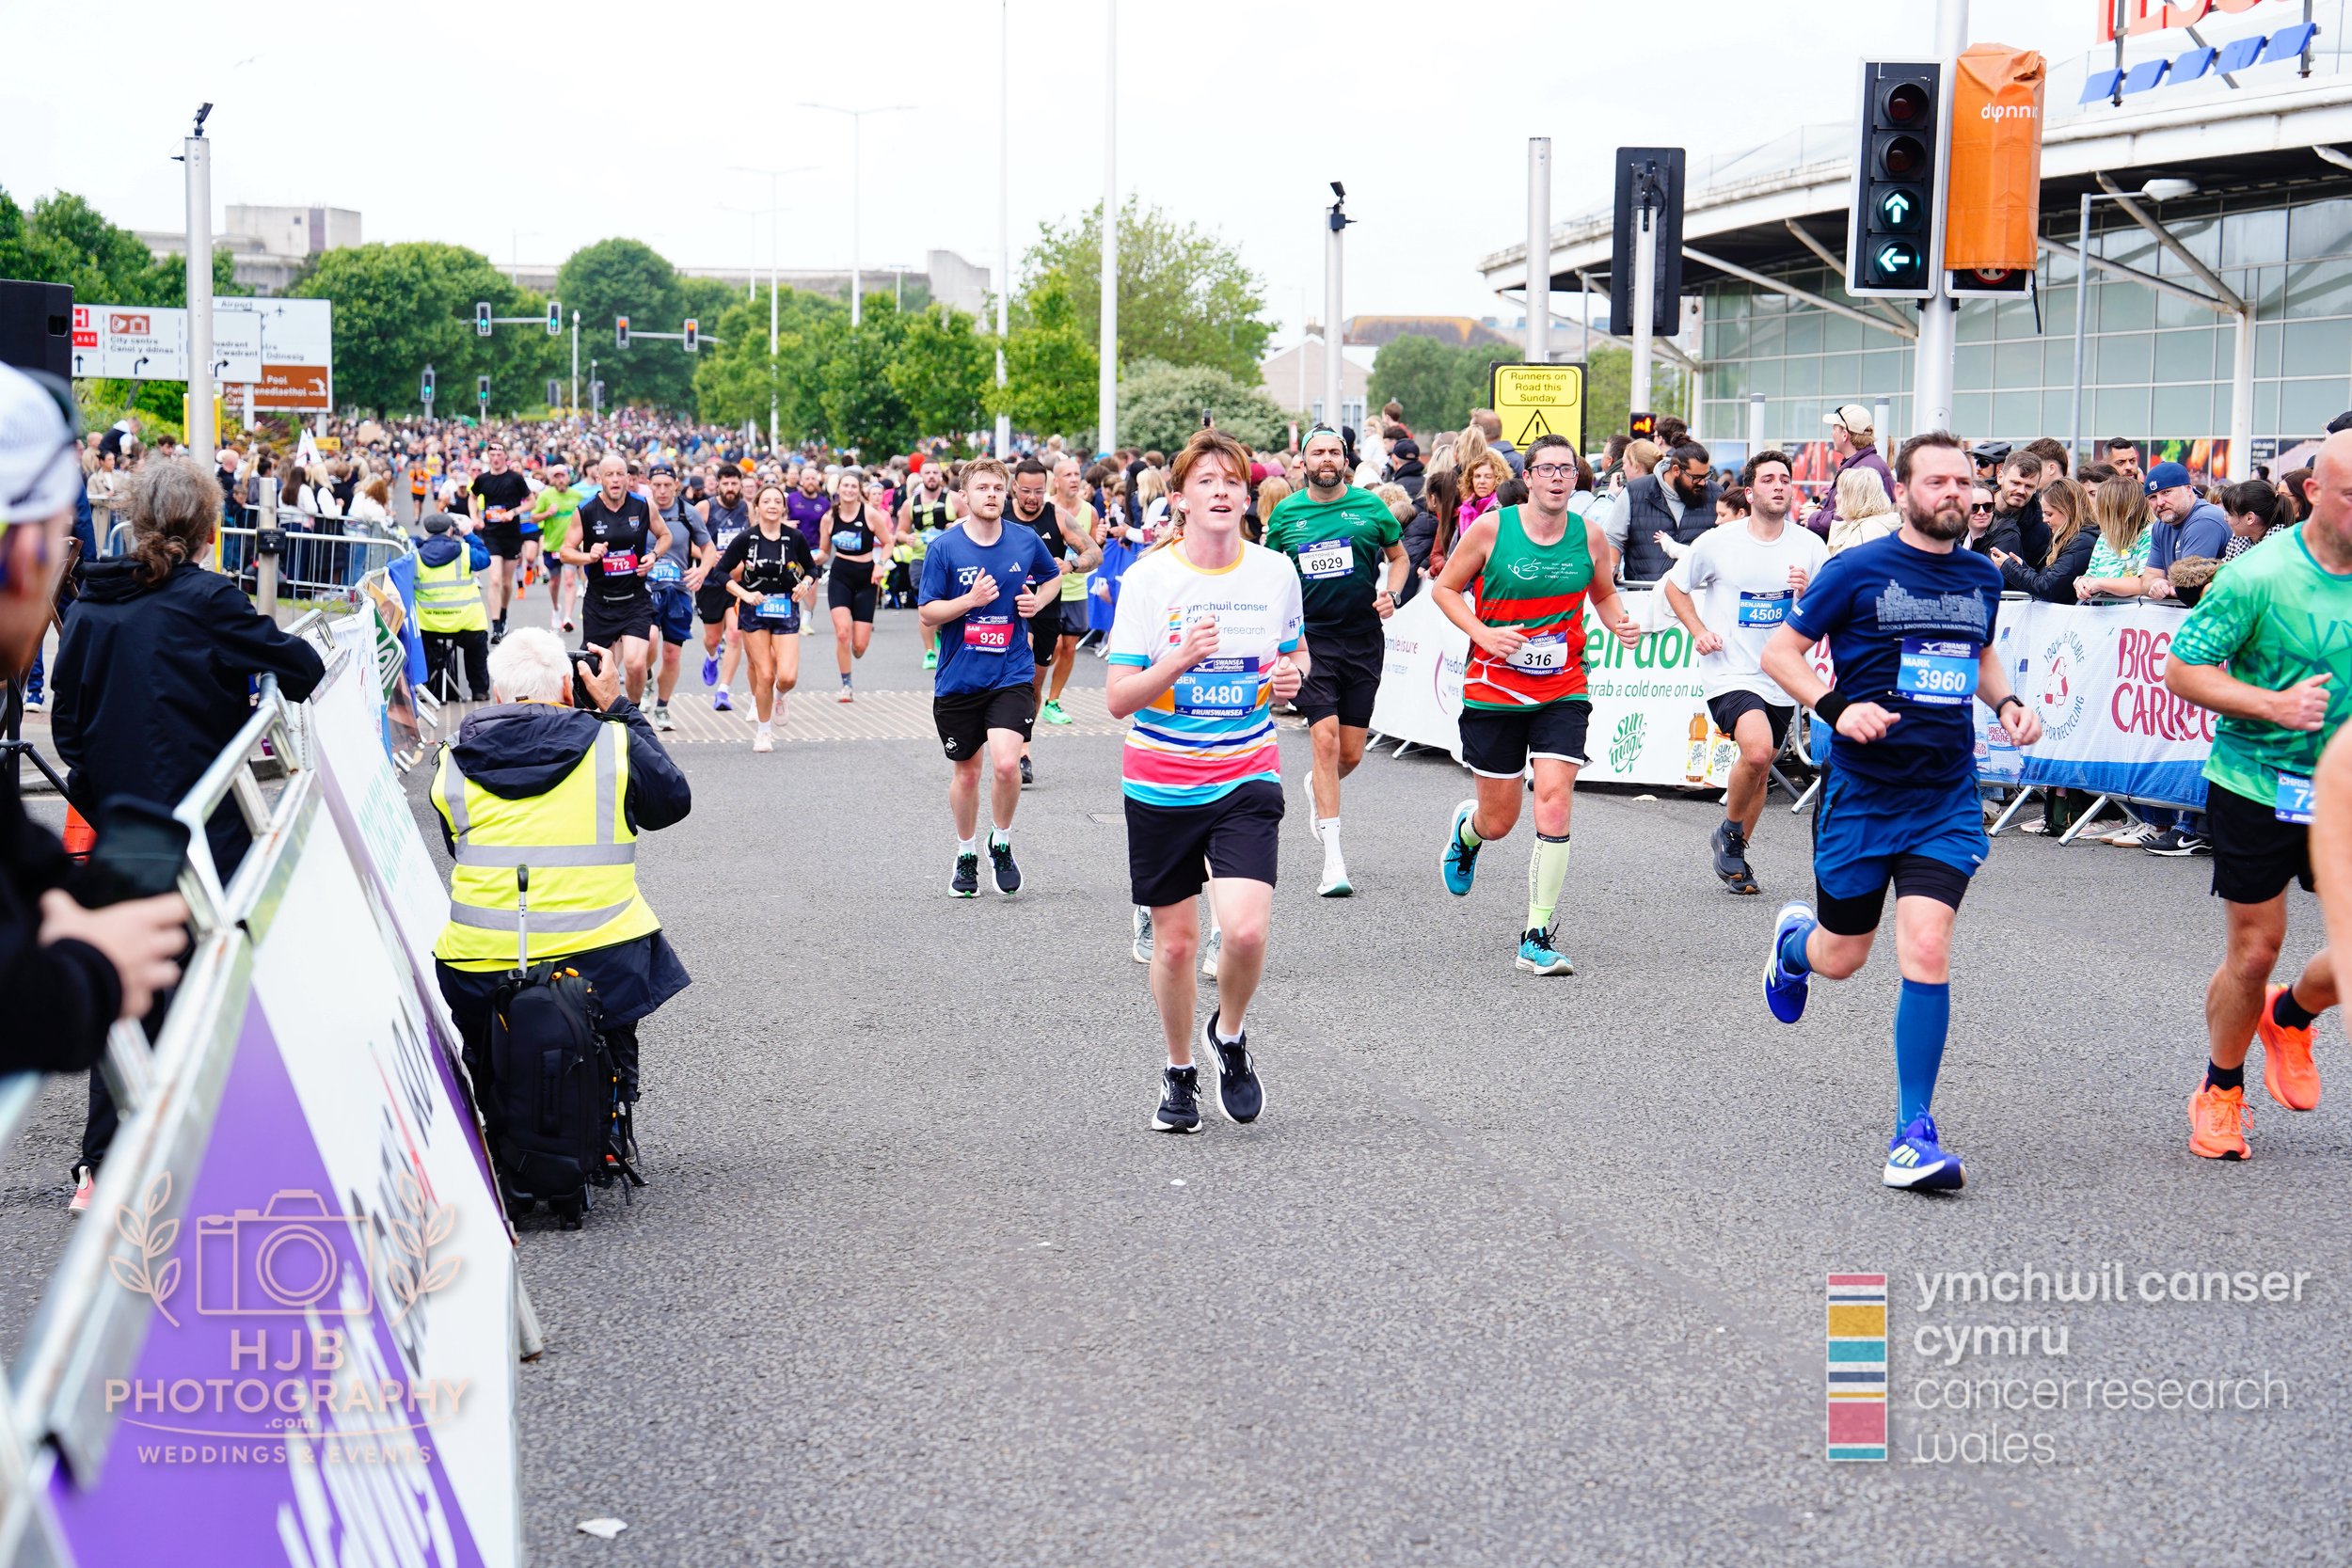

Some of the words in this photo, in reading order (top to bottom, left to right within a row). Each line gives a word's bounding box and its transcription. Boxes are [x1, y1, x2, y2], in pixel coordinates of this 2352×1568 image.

[110, 336, 127, 345] City
[1511, 372, 1551, 381] Runners
[1516, 383, 1541, 391] Road
[1544, 383, 1562, 391] this
[1520, 394, 1556, 404] Sunday
[612, 561, 630, 571] 712
[1311, 556, 1343, 572] 6929
[763, 603, 786, 613] 6814
[1186, 602, 1232, 613] ymchwil
[1234, 602, 1268, 611] canser
[1749, 609, 1782, 621] 4508
[1223, 626, 1266, 636] research
[979, 632, 1005, 644] 926
[1634, 626, 1700, 670] don
[1524, 653, 1552, 666] 316
[2117, 628, 2171, 684] BRE
[1902, 657, 1931, 668] MARK
[1176, 676, 1196, 685] BEN
[1915, 668, 1967, 692] 3960
[1587, 679, 1613, 698] grab
[1616, 686, 1622, 697] a
[1625, 679, 1650, 697] cold
[1651, 685, 1672, 697] one
[1675, 685, 1689, 697] on
[1691, 685, 1705, 697] us
[1191, 686, 1243, 705] 8480
[2279, 776, 2310, 787] CHRIS
